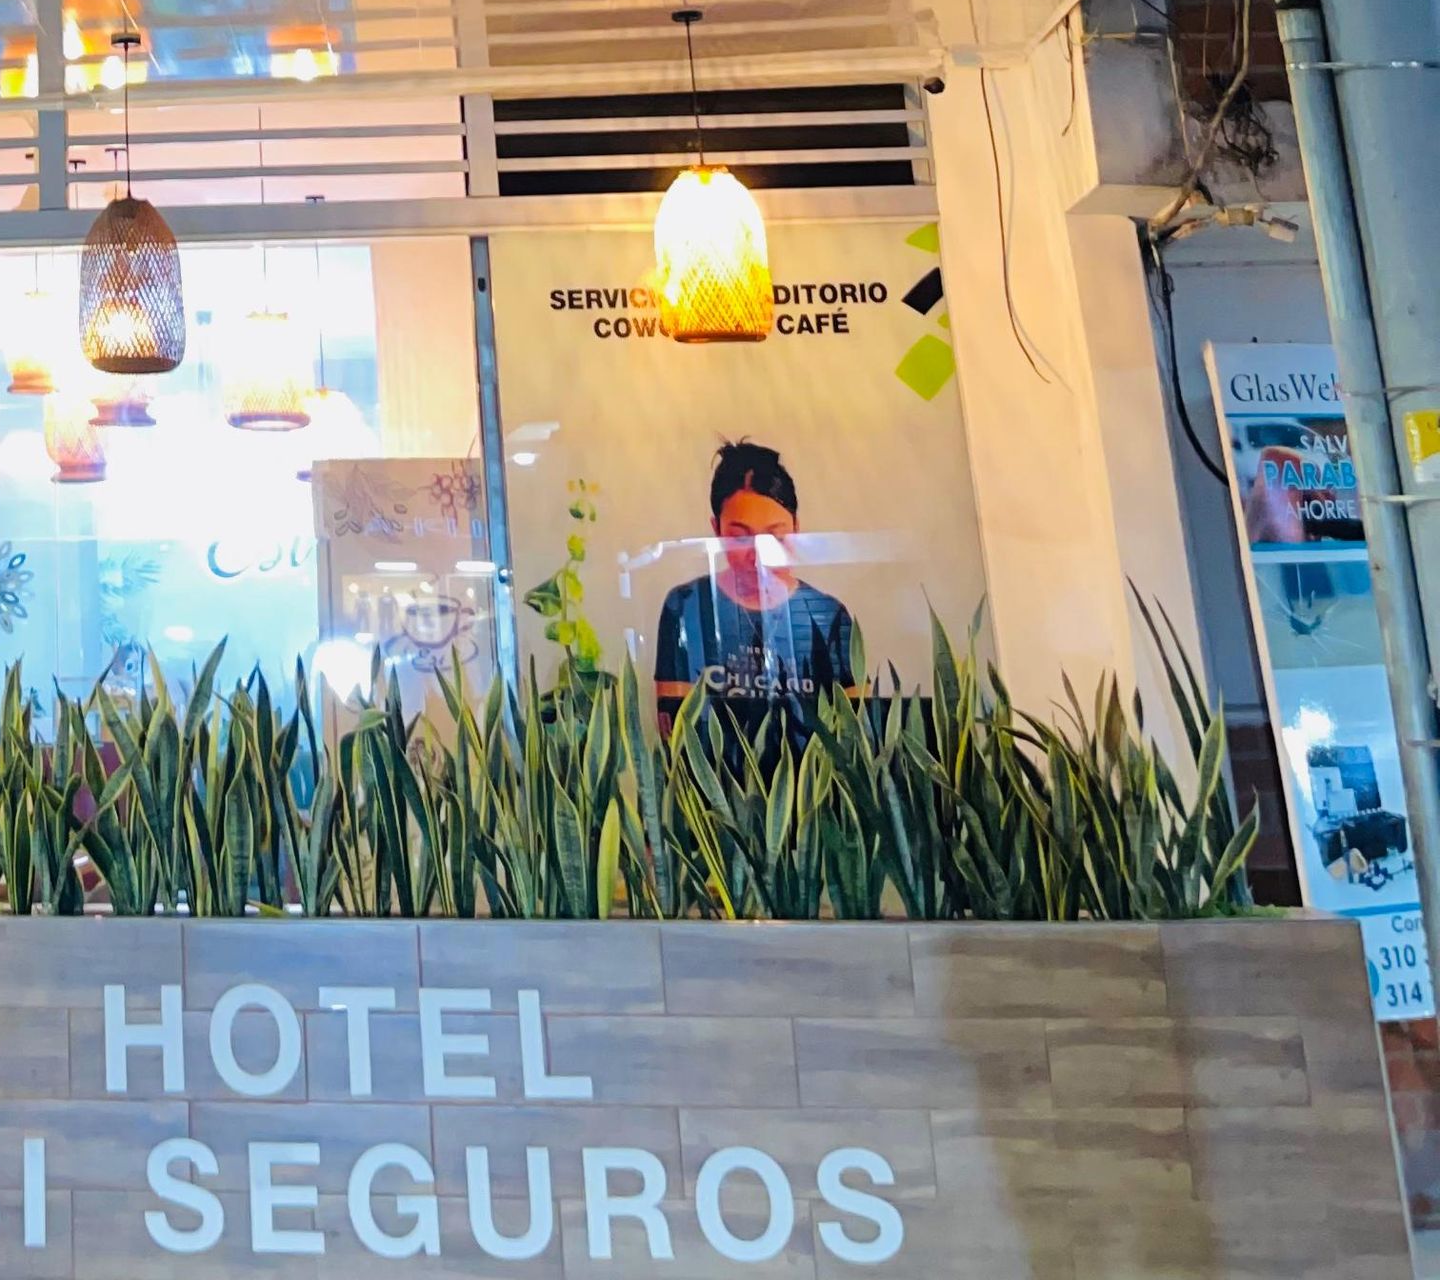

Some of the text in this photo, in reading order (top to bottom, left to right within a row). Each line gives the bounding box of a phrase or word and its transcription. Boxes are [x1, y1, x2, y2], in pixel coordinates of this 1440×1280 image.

[550, 282, 888, 310] SERVICI DITORIO
[776, 307, 850, 335] CAFÉ
[1230, 372, 1341, 403] GlasWel
[1300, 434, 1348, 453] SALV
[1263, 459, 1357, 490] PARAB
[1380, 944, 1416, 970] 310
[1386, 982, 1422, 1007] 314
[103, 983, 594, 1100] HOTEL
[143, 1137, 905, 1264] SEGUROS
